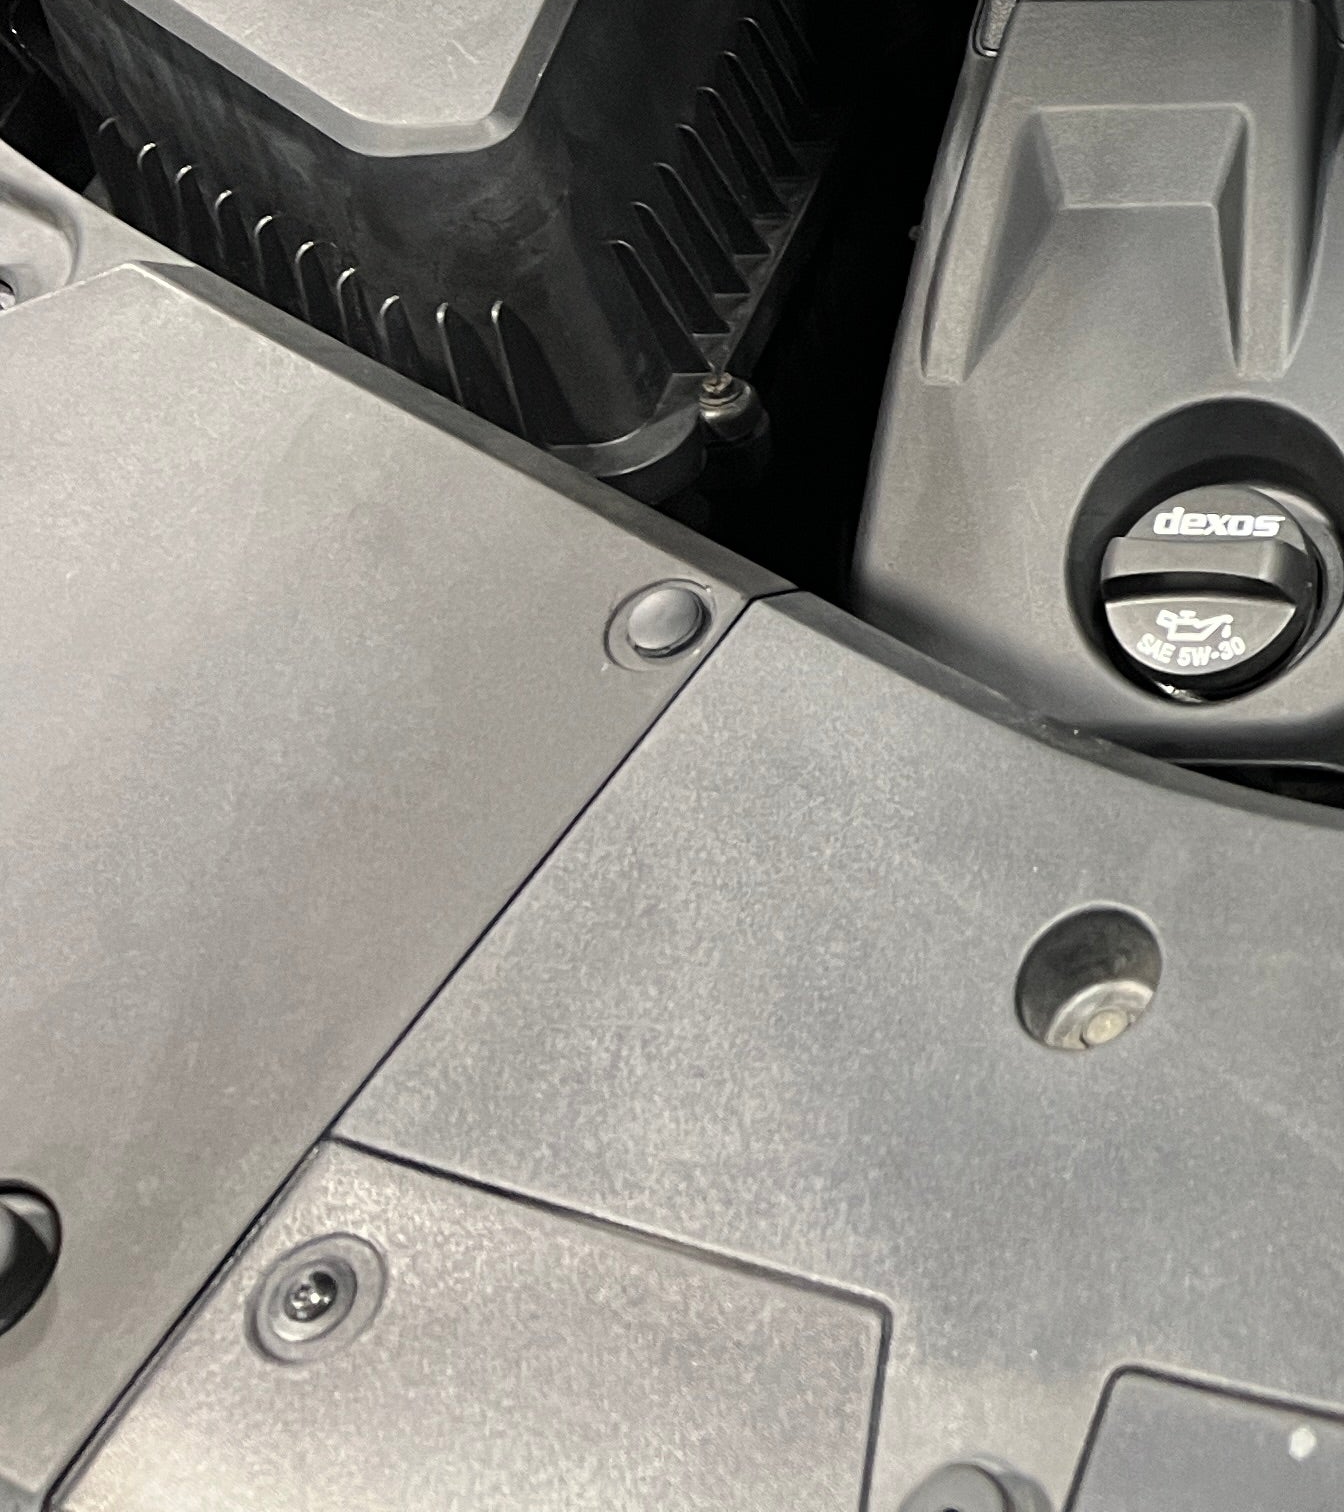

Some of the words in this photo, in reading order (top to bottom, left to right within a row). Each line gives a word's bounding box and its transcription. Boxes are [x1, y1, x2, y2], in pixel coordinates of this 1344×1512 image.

[1153, 506, 1286, 537] dexos
[1136, 632, 1176, 663] SAE
[1177, 636, 1246, 667] 5W-30
